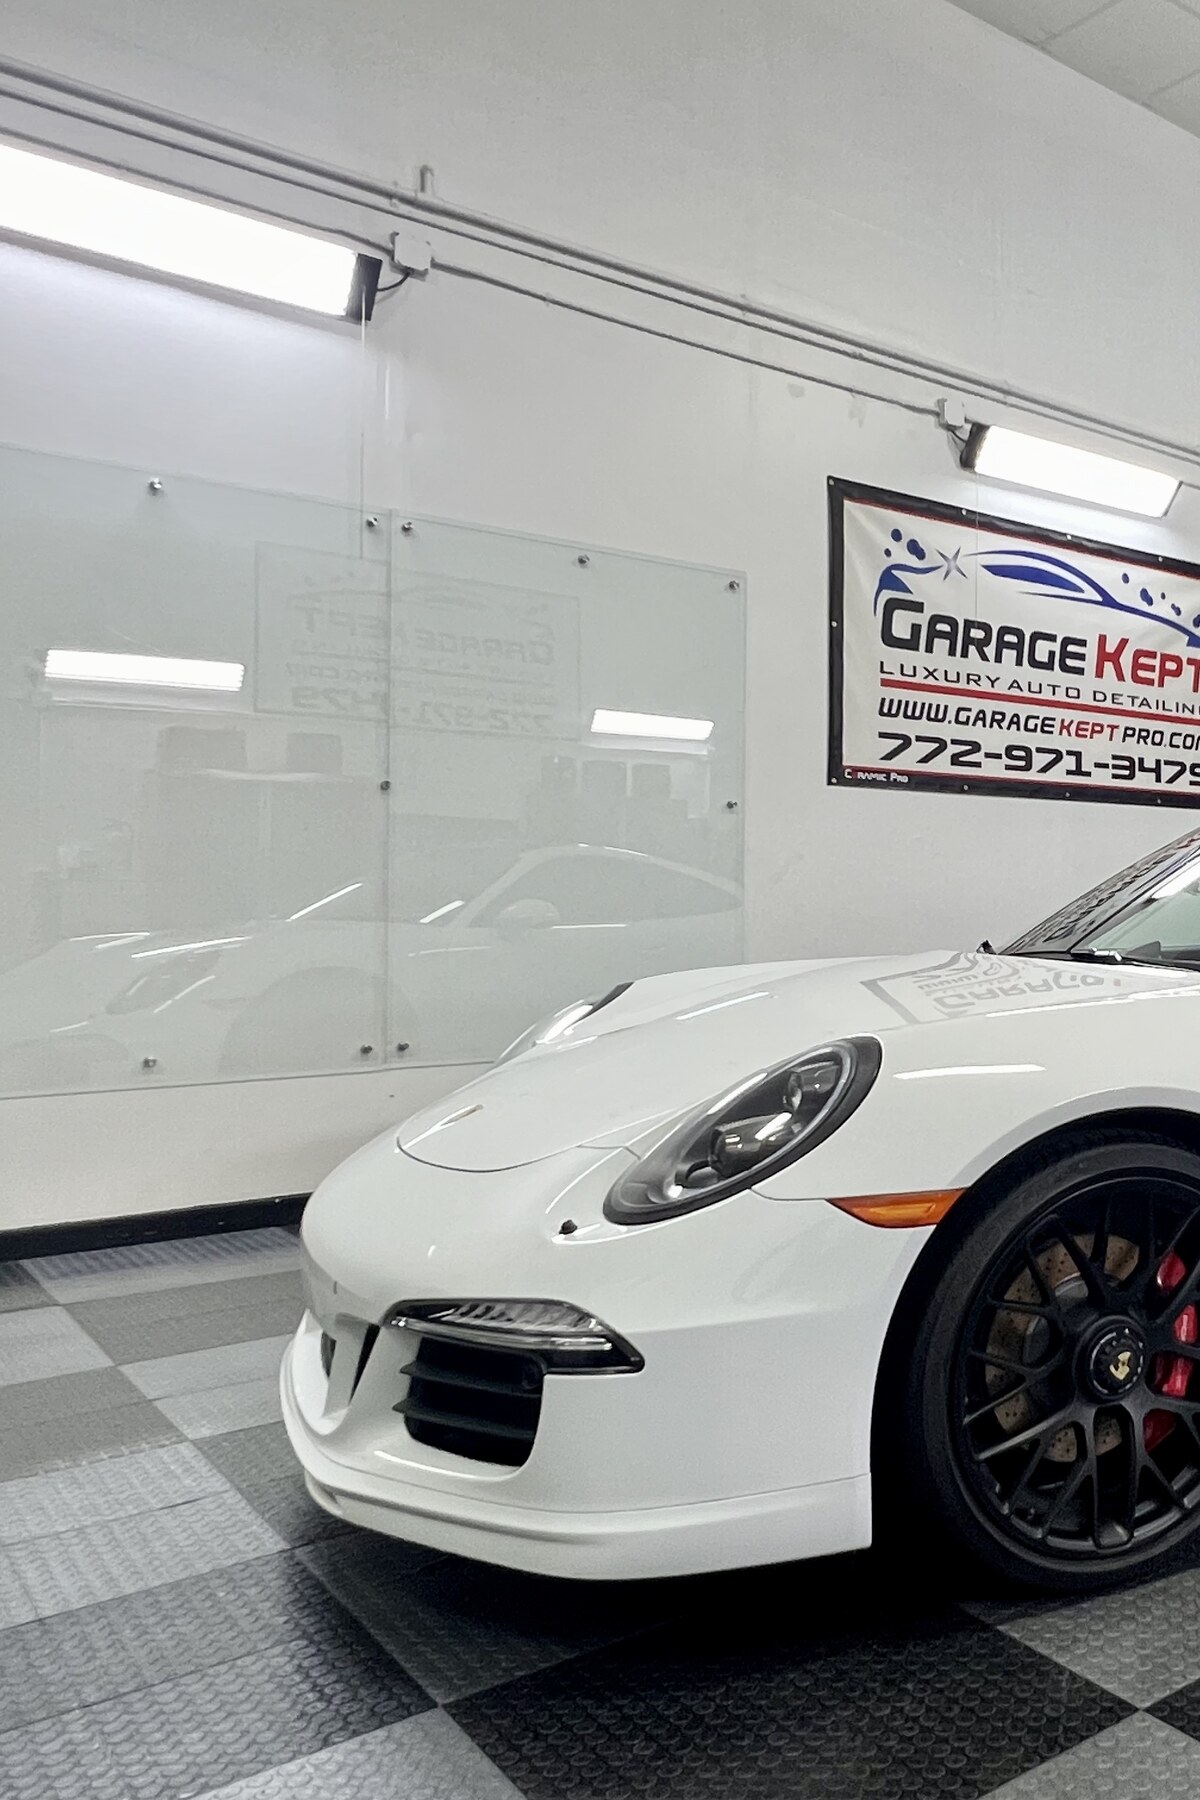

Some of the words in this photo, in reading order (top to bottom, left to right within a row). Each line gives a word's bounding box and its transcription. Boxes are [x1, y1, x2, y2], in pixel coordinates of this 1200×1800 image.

[881, 597, 1087, 676] GARAGE
[880, 661, 1000, 688] LUXURY
[1007, 679, 1081, 700] AUTO
[844, 769, 887, 782] CRAMIC
